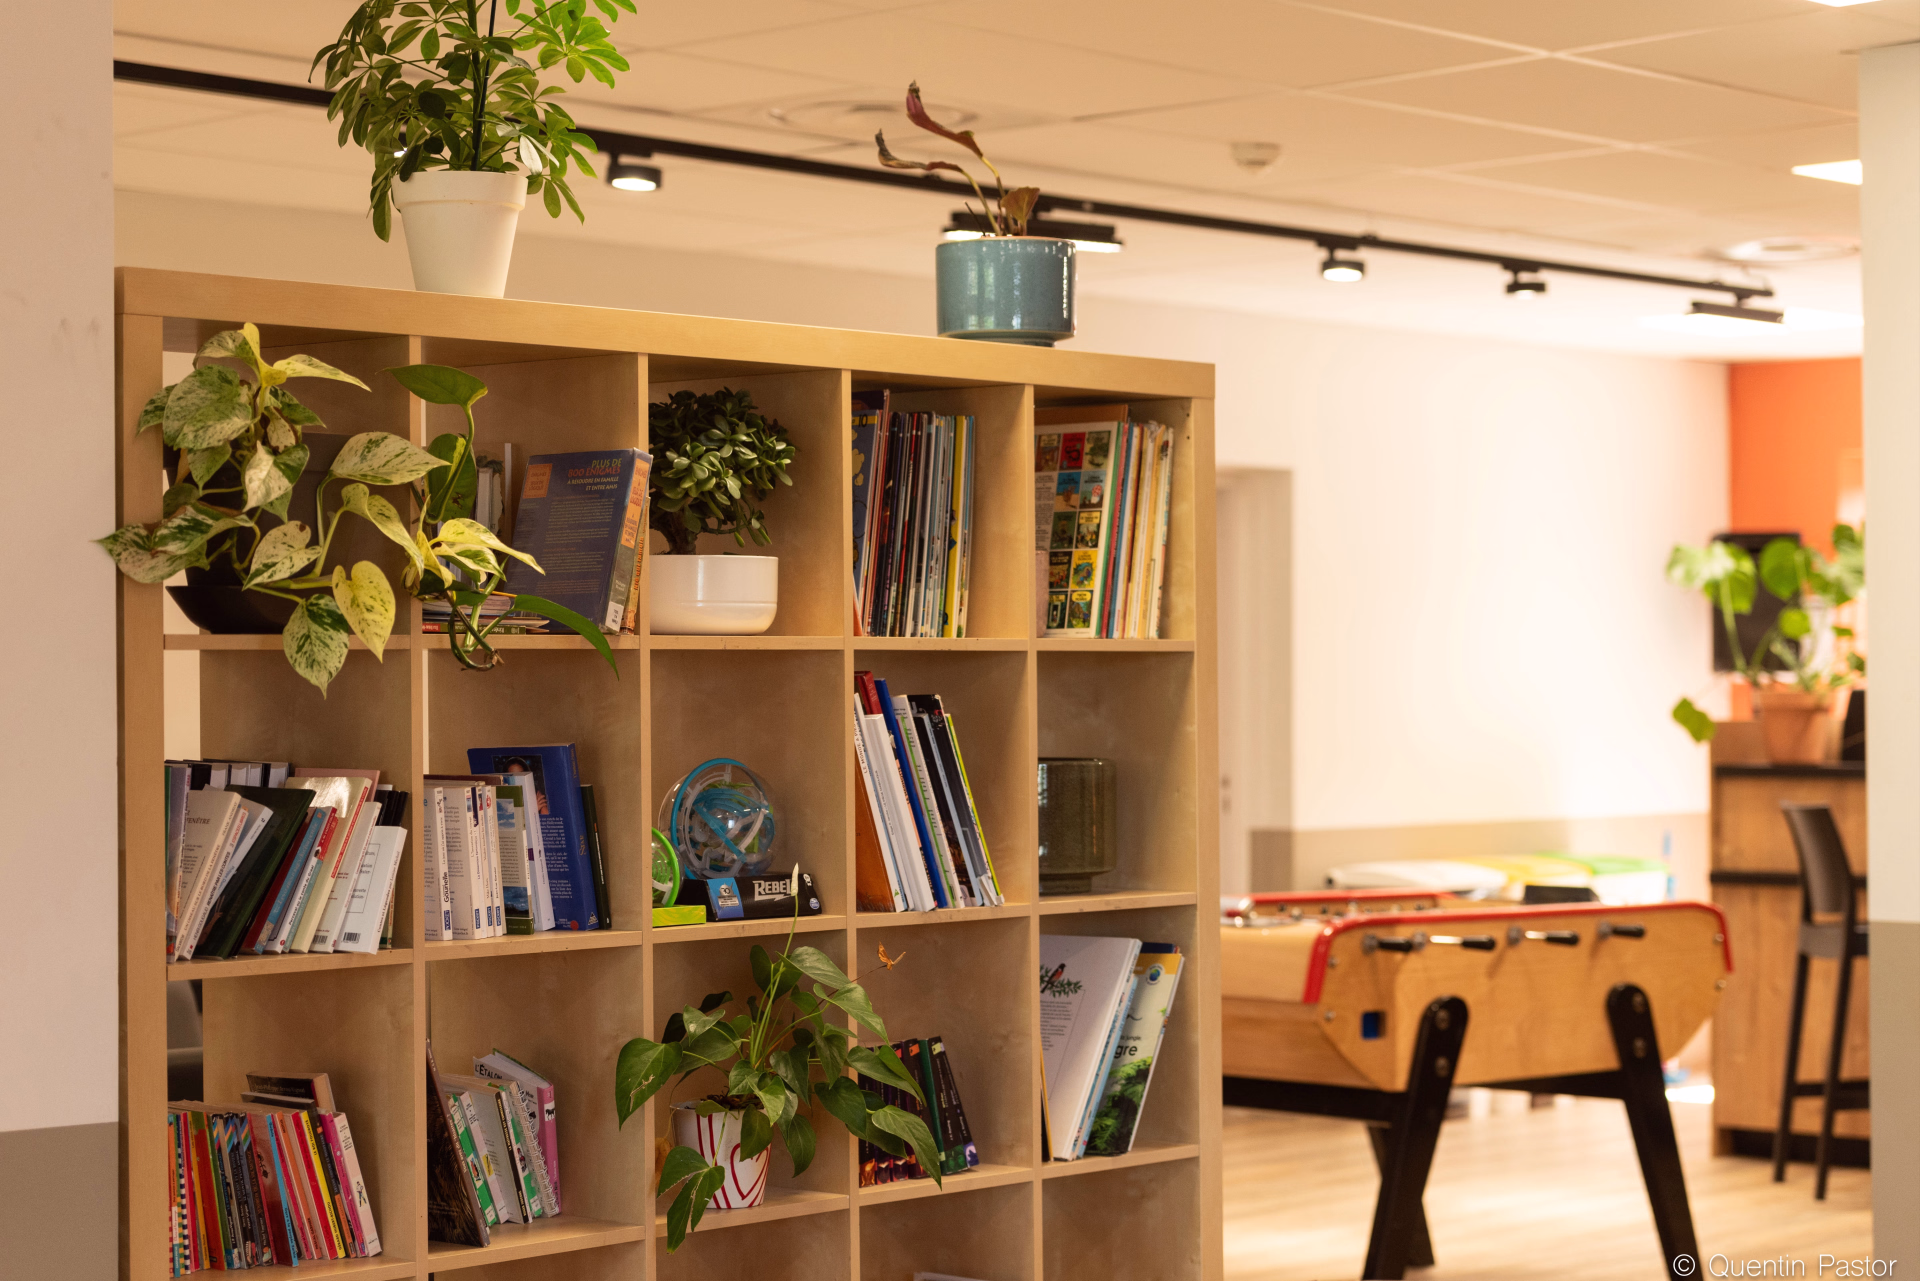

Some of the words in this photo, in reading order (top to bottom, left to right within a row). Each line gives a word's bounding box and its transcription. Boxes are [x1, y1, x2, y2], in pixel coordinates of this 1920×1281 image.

[858, 414, 868, 428] 10
[592, 459, 610, 468] PLUS
[612, 458, 622, 466] DE
[568, 469, 584, 478] 800
[442, 872, 450, 903] Gounelle
